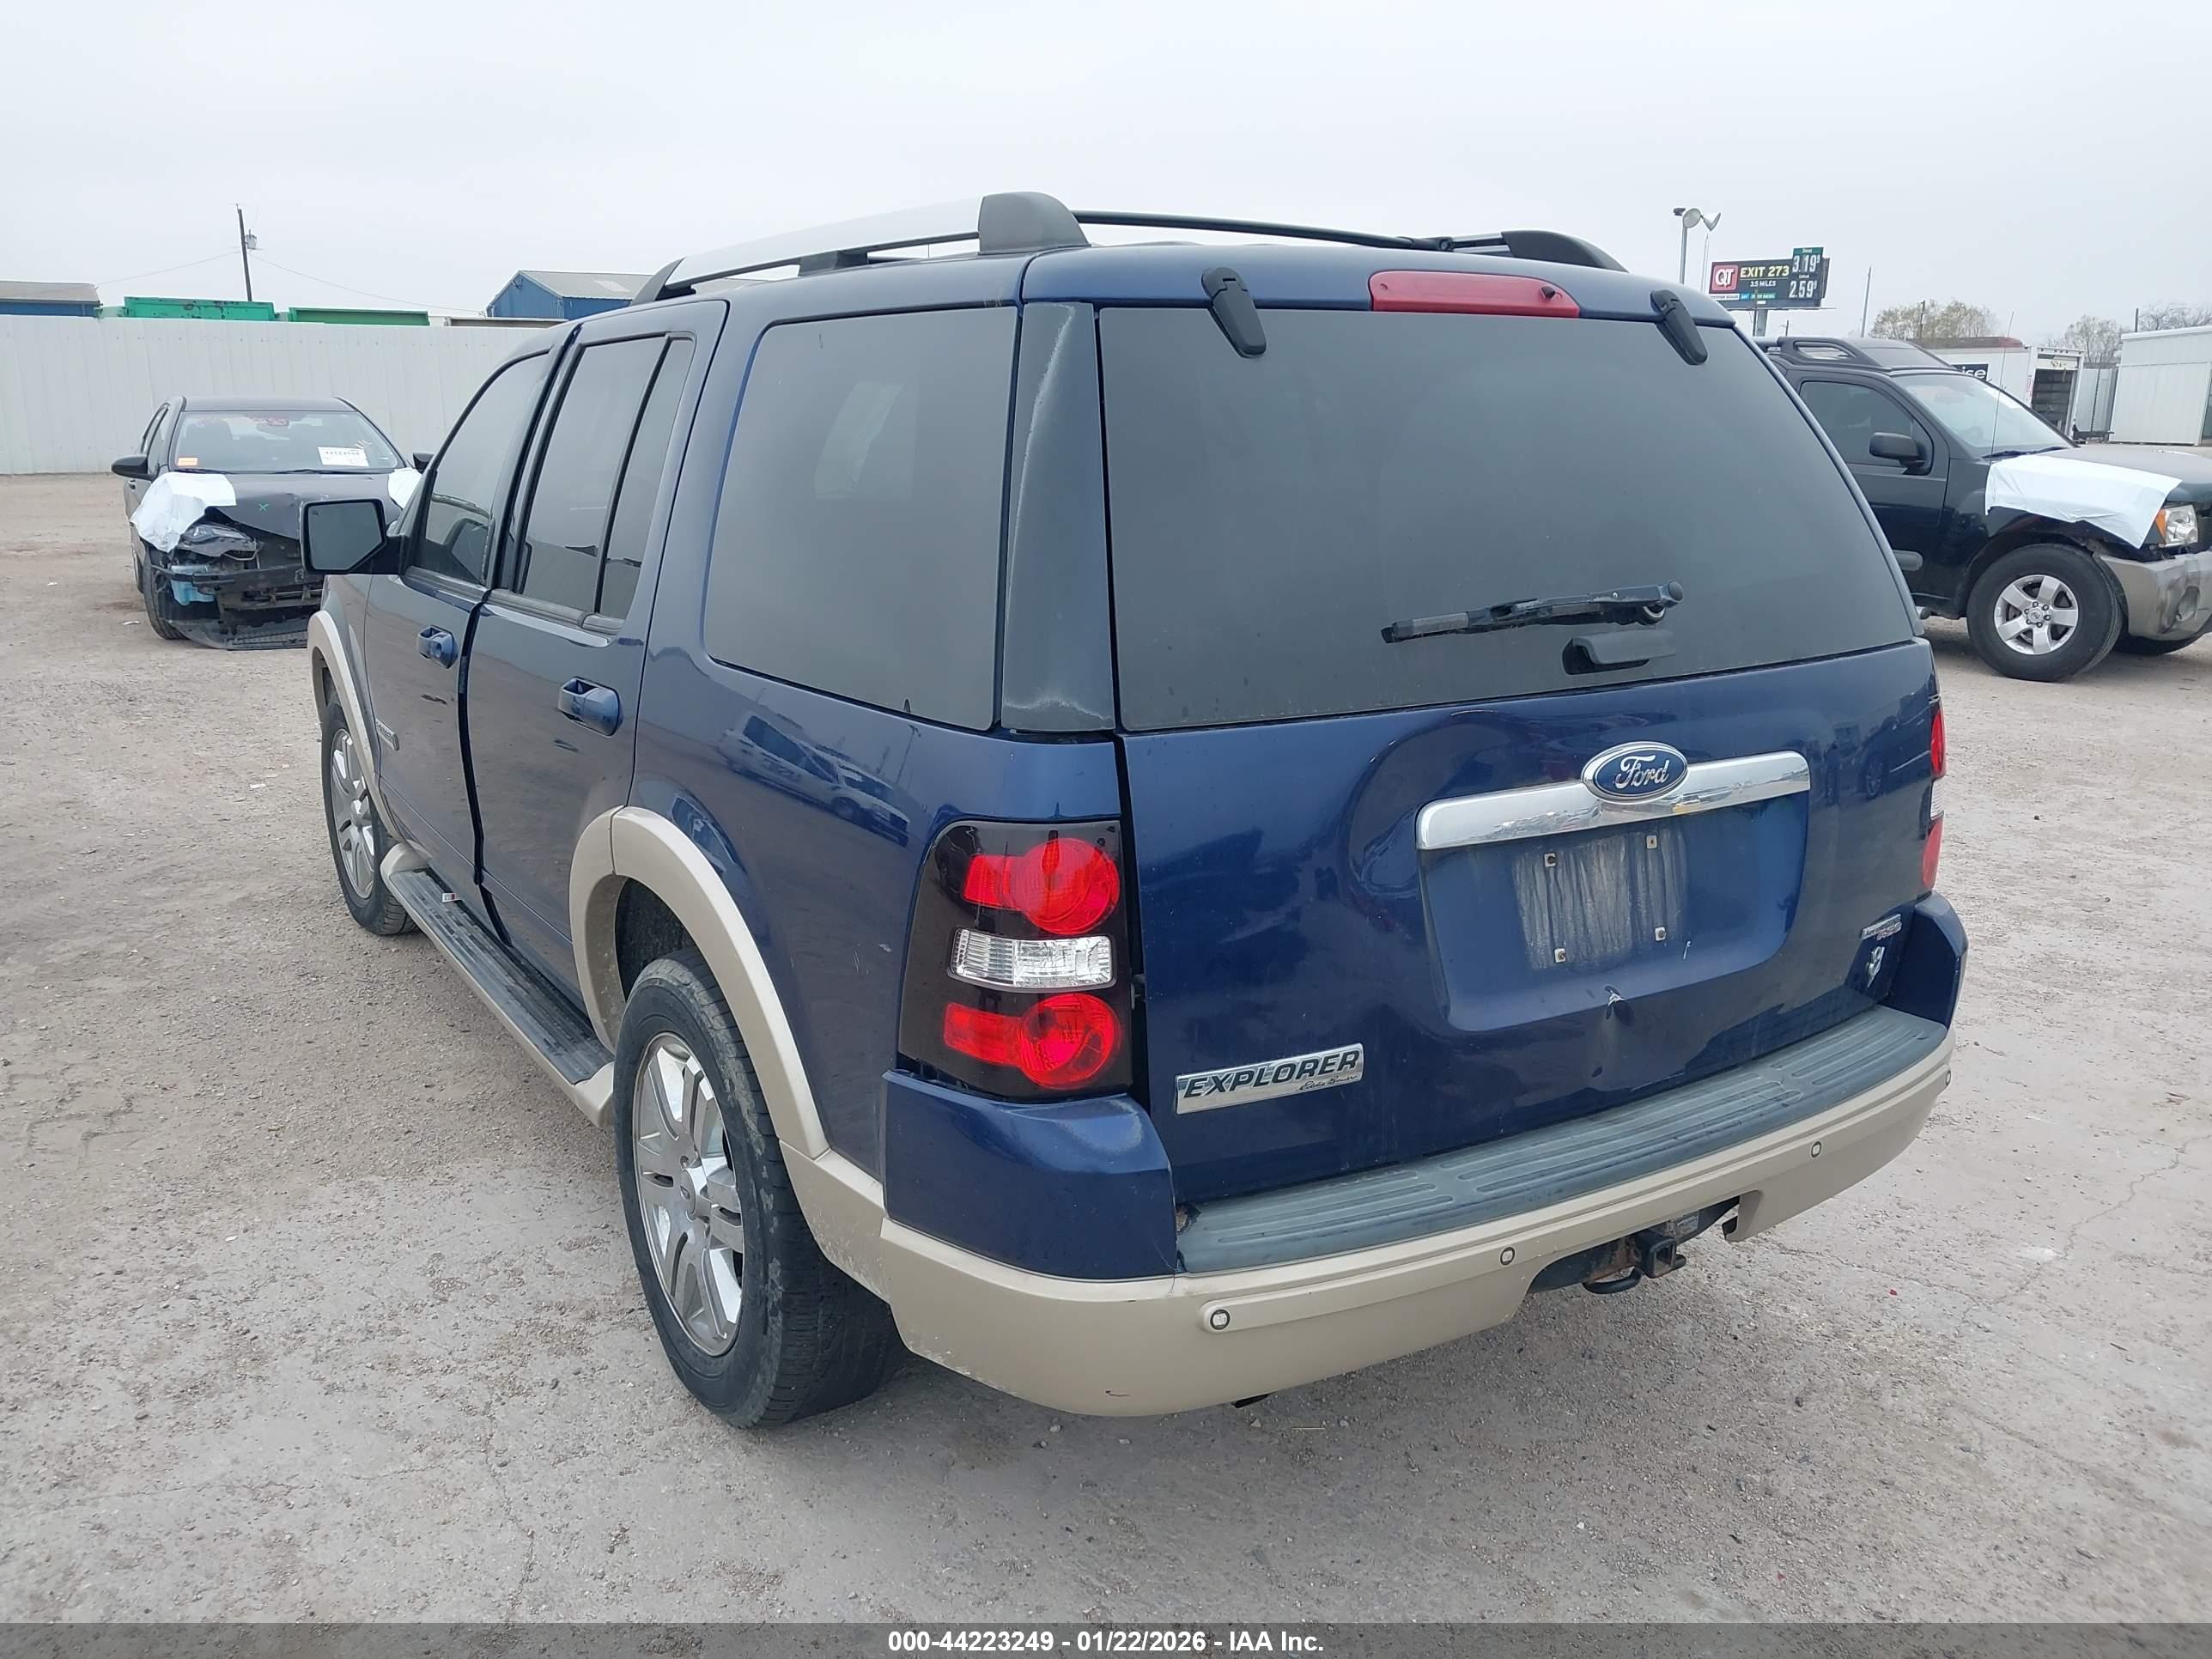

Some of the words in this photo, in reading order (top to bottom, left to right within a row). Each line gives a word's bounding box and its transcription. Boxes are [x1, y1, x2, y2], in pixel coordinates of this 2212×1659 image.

[1715, 268, 1735, 288] QT
[1740, 267, 1766, 278] EXIT
[1767, 265, 1790, 277] 273
[1613, 754, 1670, 789] Ford
[1182, 1049, 1361, 1098] EXPLORER
